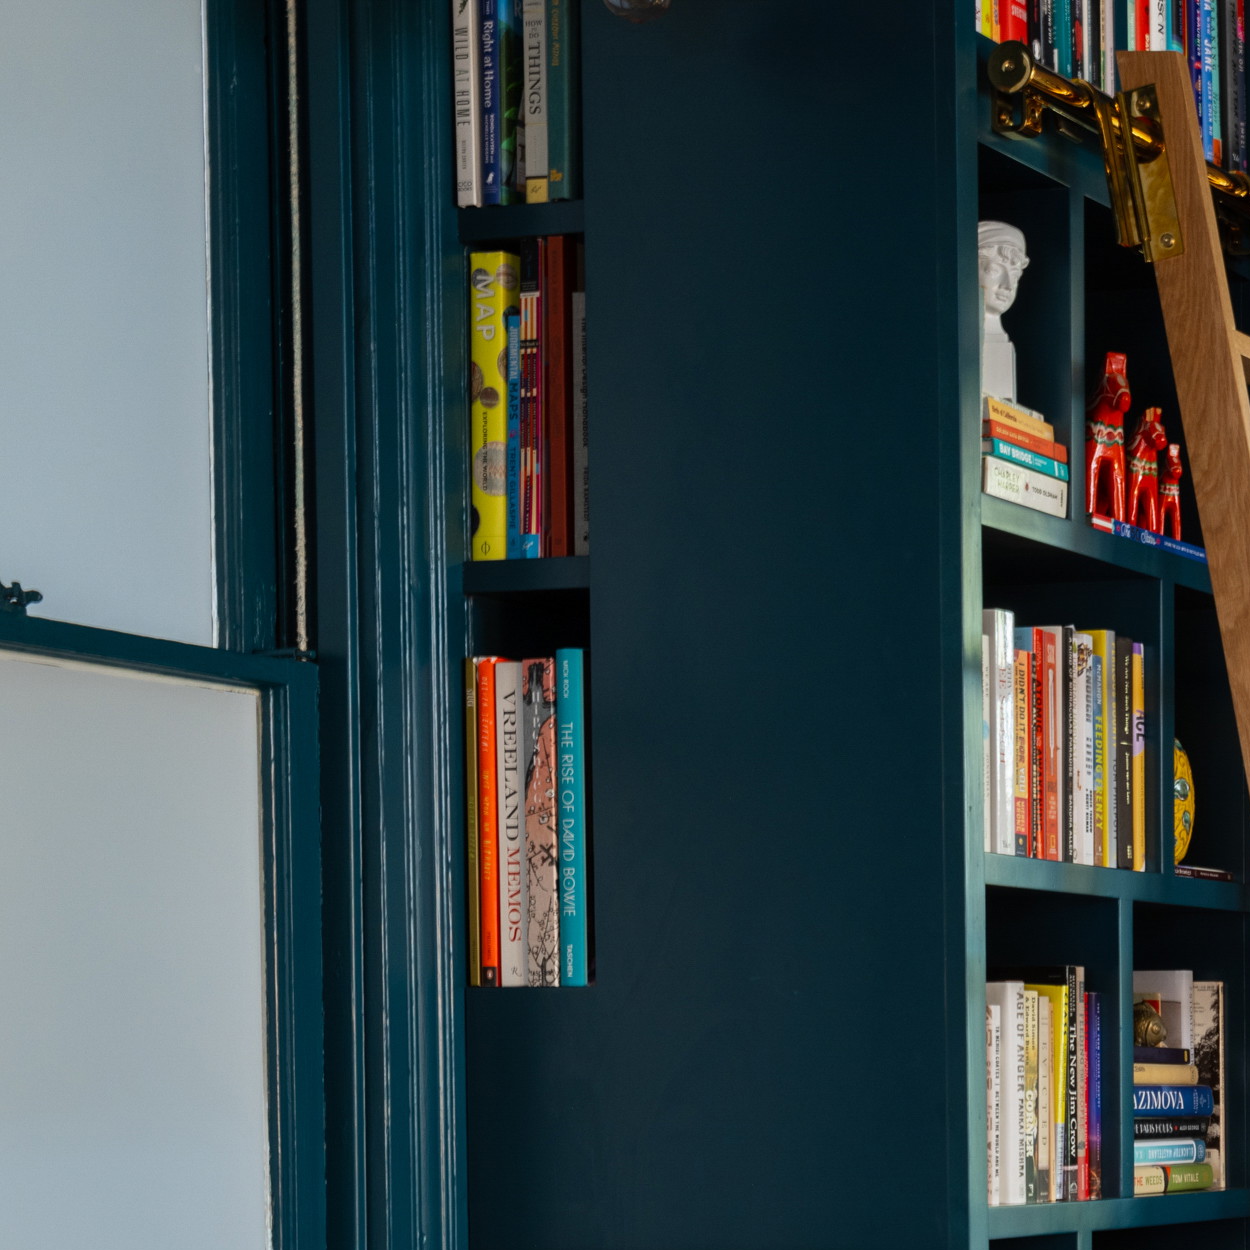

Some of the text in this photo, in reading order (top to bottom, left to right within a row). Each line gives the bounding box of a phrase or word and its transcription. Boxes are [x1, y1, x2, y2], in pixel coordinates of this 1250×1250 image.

[455, 27, 471, 127] WILD AT HOME
[483, 21, 498, 108] Right at Home
[528, 42, 541, 115] THINGS
[1204, 39, 1212, 72] JANE
[475, 275, 496, 341] MAP
[509, 326, 520, 420] JUDGMENTAL MAPS
[998, 442, 1011, 456] BAY
[1011, 448, 1033, 465] BRIDGE
[509, 480, 517, 529] GILLASPIE
[1018, 668, 1026, 735] DIDN'T DO IT
[1124, 655, 1132, 735] We Things
[1035, 680, 1044, 832] ATOMIC AWAKENING
[1095, 715, 1103, 832] FEEDING FRENZY
[503, 689, 523, 943] VREELAND MEMOS
[560, 721, 576, 918] THE RISE OF DAVID BOWIE
[566, 944, 574, 978] TASCHEN
[1017, 992, 1025, 1093] AGE OF ANGER
[1069, 1023, 1077, 1050] The
[1068, 1089, 1078, 1116] Jim
[1069, 1054, 1077, 1087] New
[1025, 1090, 1035, 1158] CORNER
[1145, 1175, 1163, 1186] WEEDS
[1171, 1173, 1199, 1184] TOM VITALE
